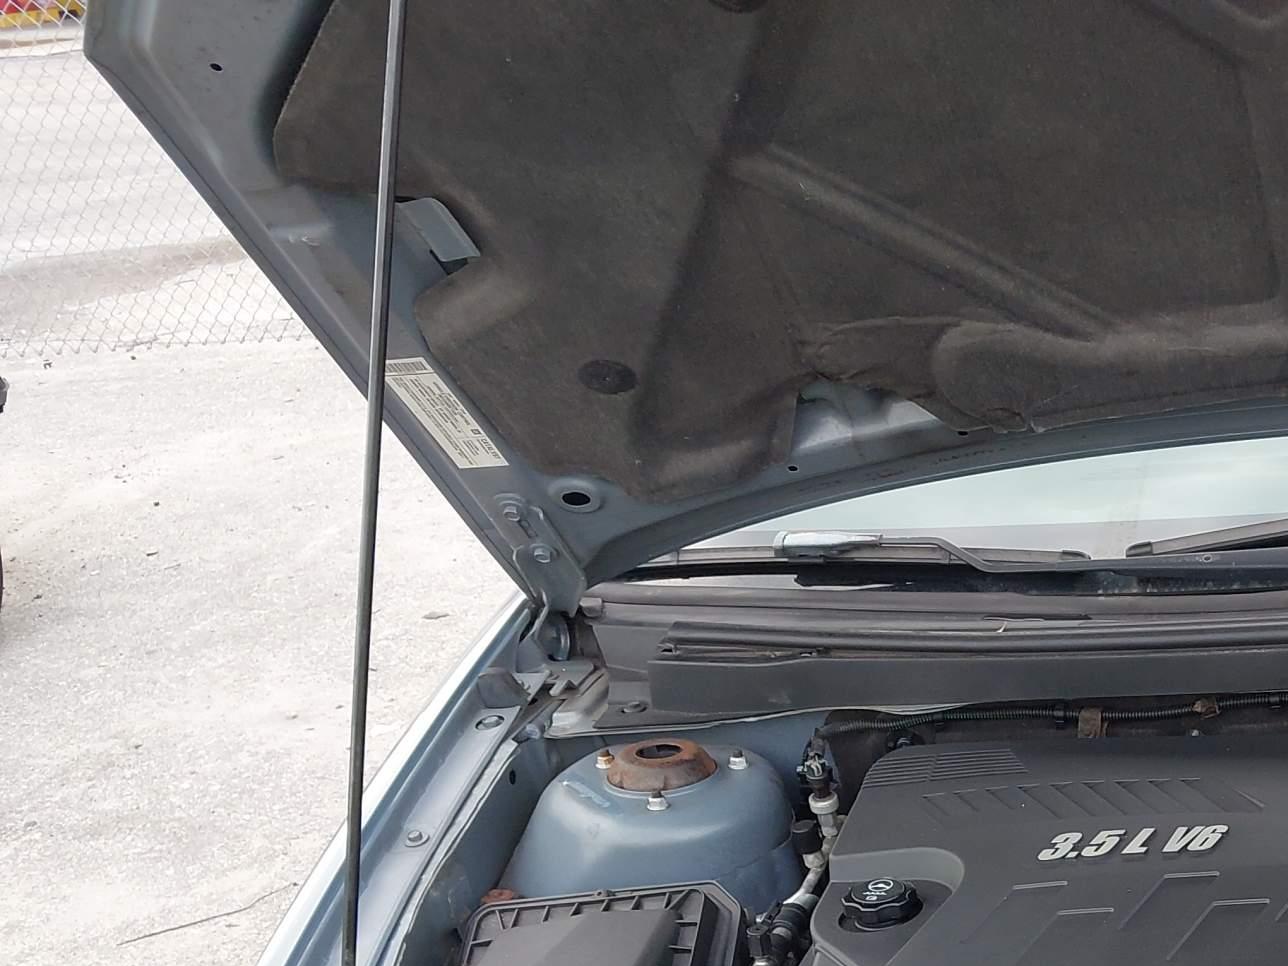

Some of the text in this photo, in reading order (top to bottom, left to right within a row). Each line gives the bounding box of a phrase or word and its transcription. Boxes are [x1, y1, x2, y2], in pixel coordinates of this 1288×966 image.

[1037, 824, 1229, 861] 3.5 L V6
